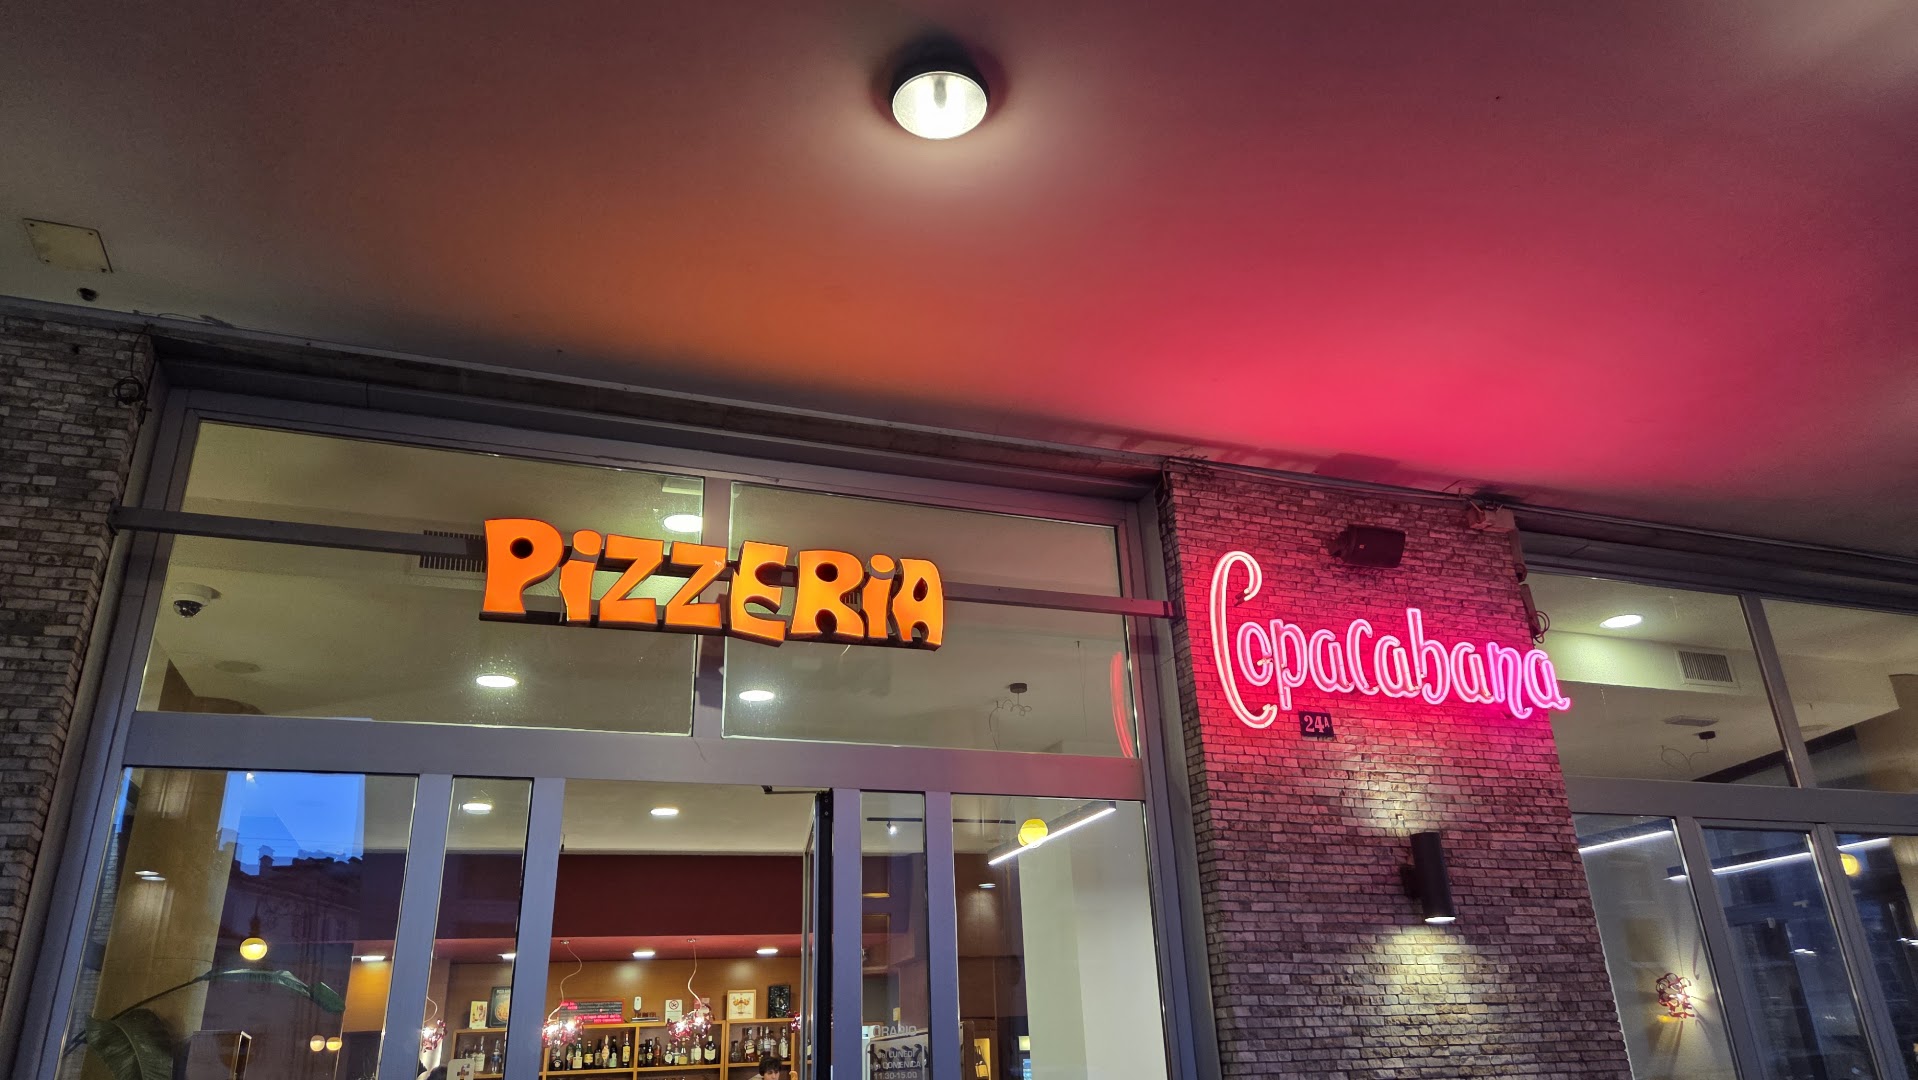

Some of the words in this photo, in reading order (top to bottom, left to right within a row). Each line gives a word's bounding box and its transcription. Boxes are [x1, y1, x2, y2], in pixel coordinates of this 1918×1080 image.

[1210, 550, 1571, 729] Copacabana
[1303, 715, 1330, 733] 24A
[873, 1025, 917, 1037] ORARIO
